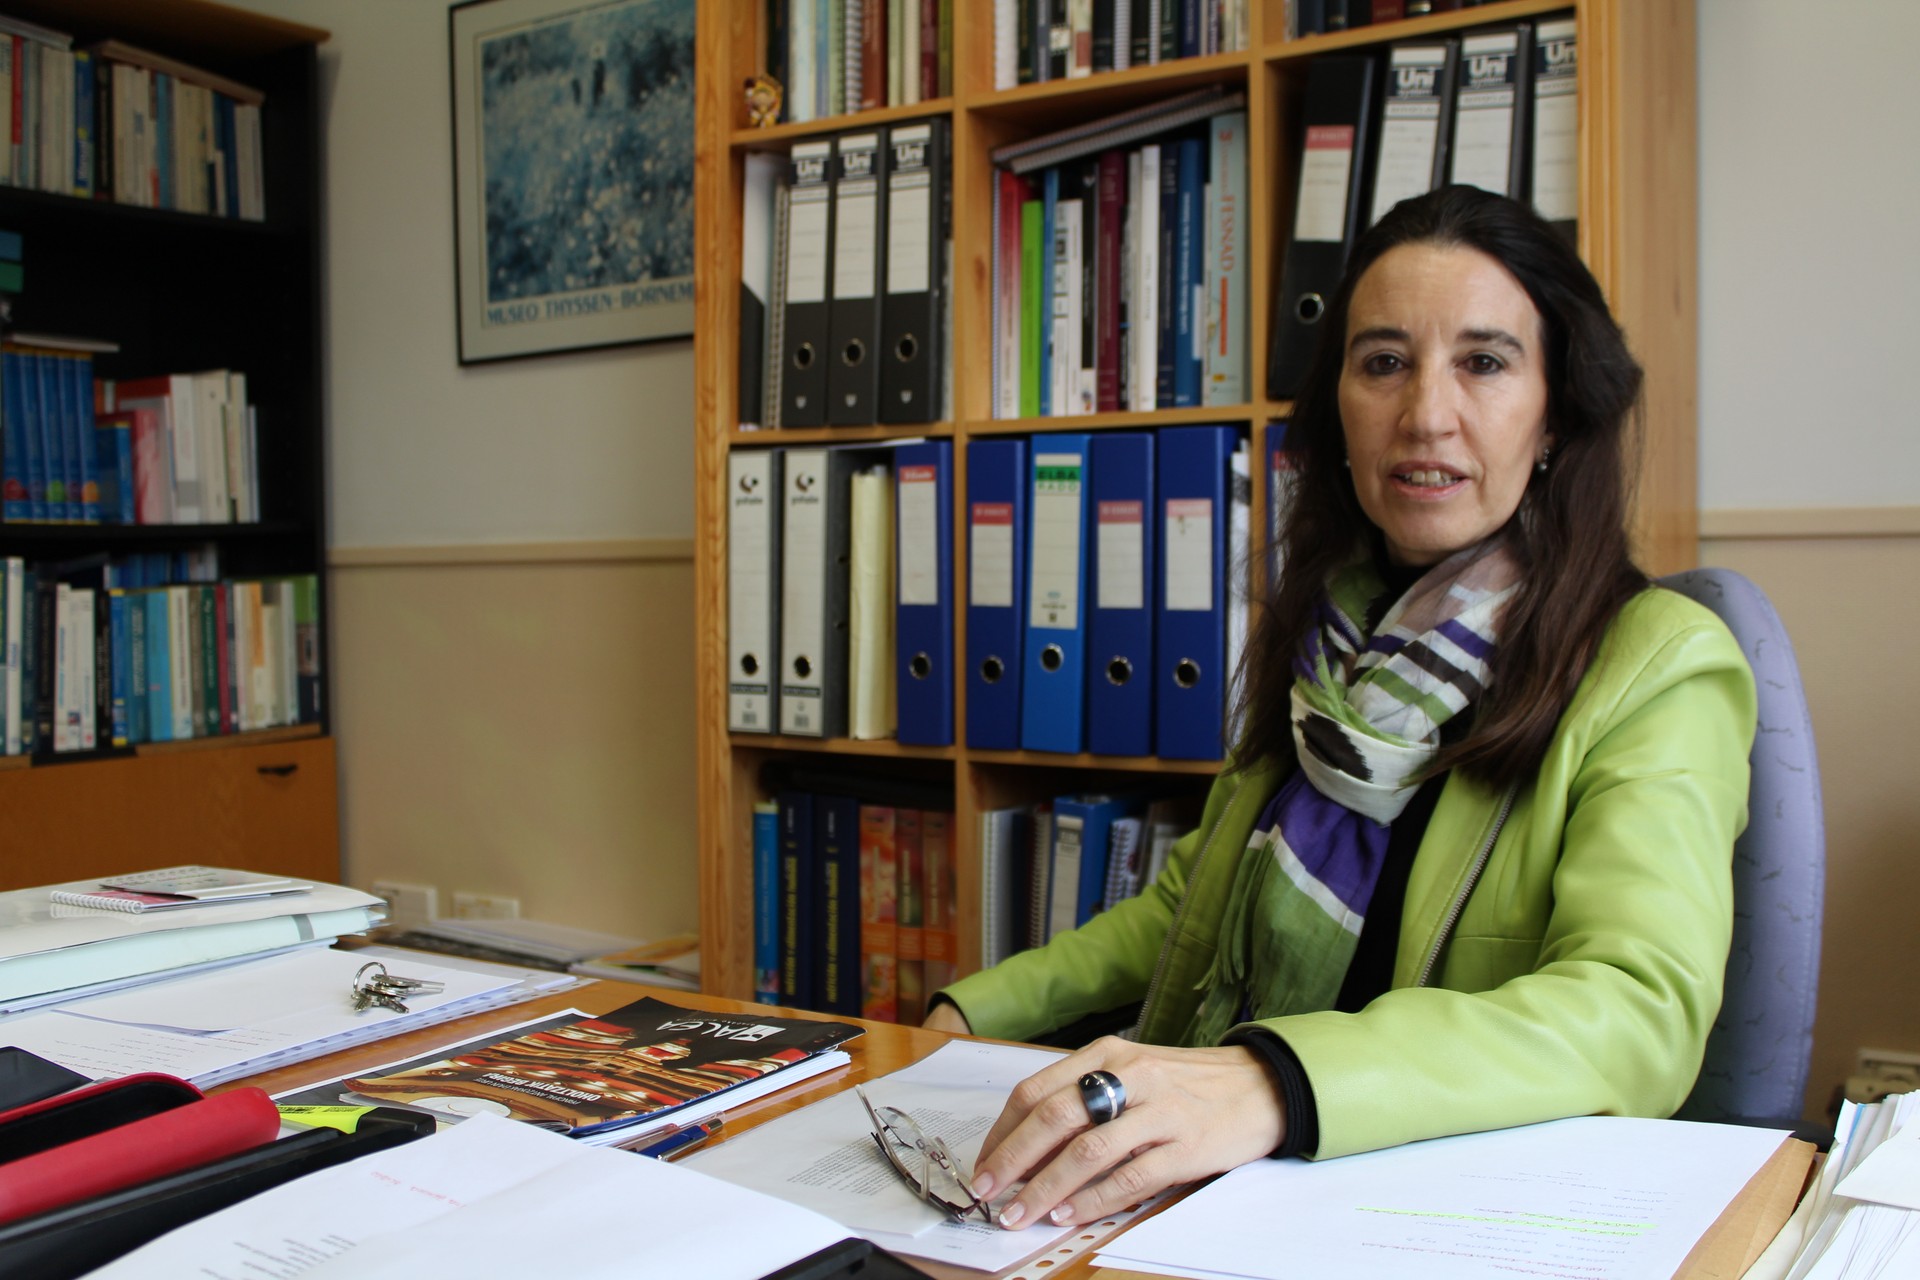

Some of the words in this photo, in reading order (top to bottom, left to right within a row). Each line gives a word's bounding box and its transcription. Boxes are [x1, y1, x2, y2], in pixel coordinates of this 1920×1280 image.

[1469, 55, 1507, 79] Uni
[1397, 66, 1435, 90] Uni
[844, 151, 871, 171] Uni
[896, 143, 924, 162] Uni
[796, 159, 824, 178] Uni
[487, 303, 537, 325] MUSEO
[1038, 470, 1078, 480] ELBA
[527, 1081, 602, 1102] OHOLTZATIK
